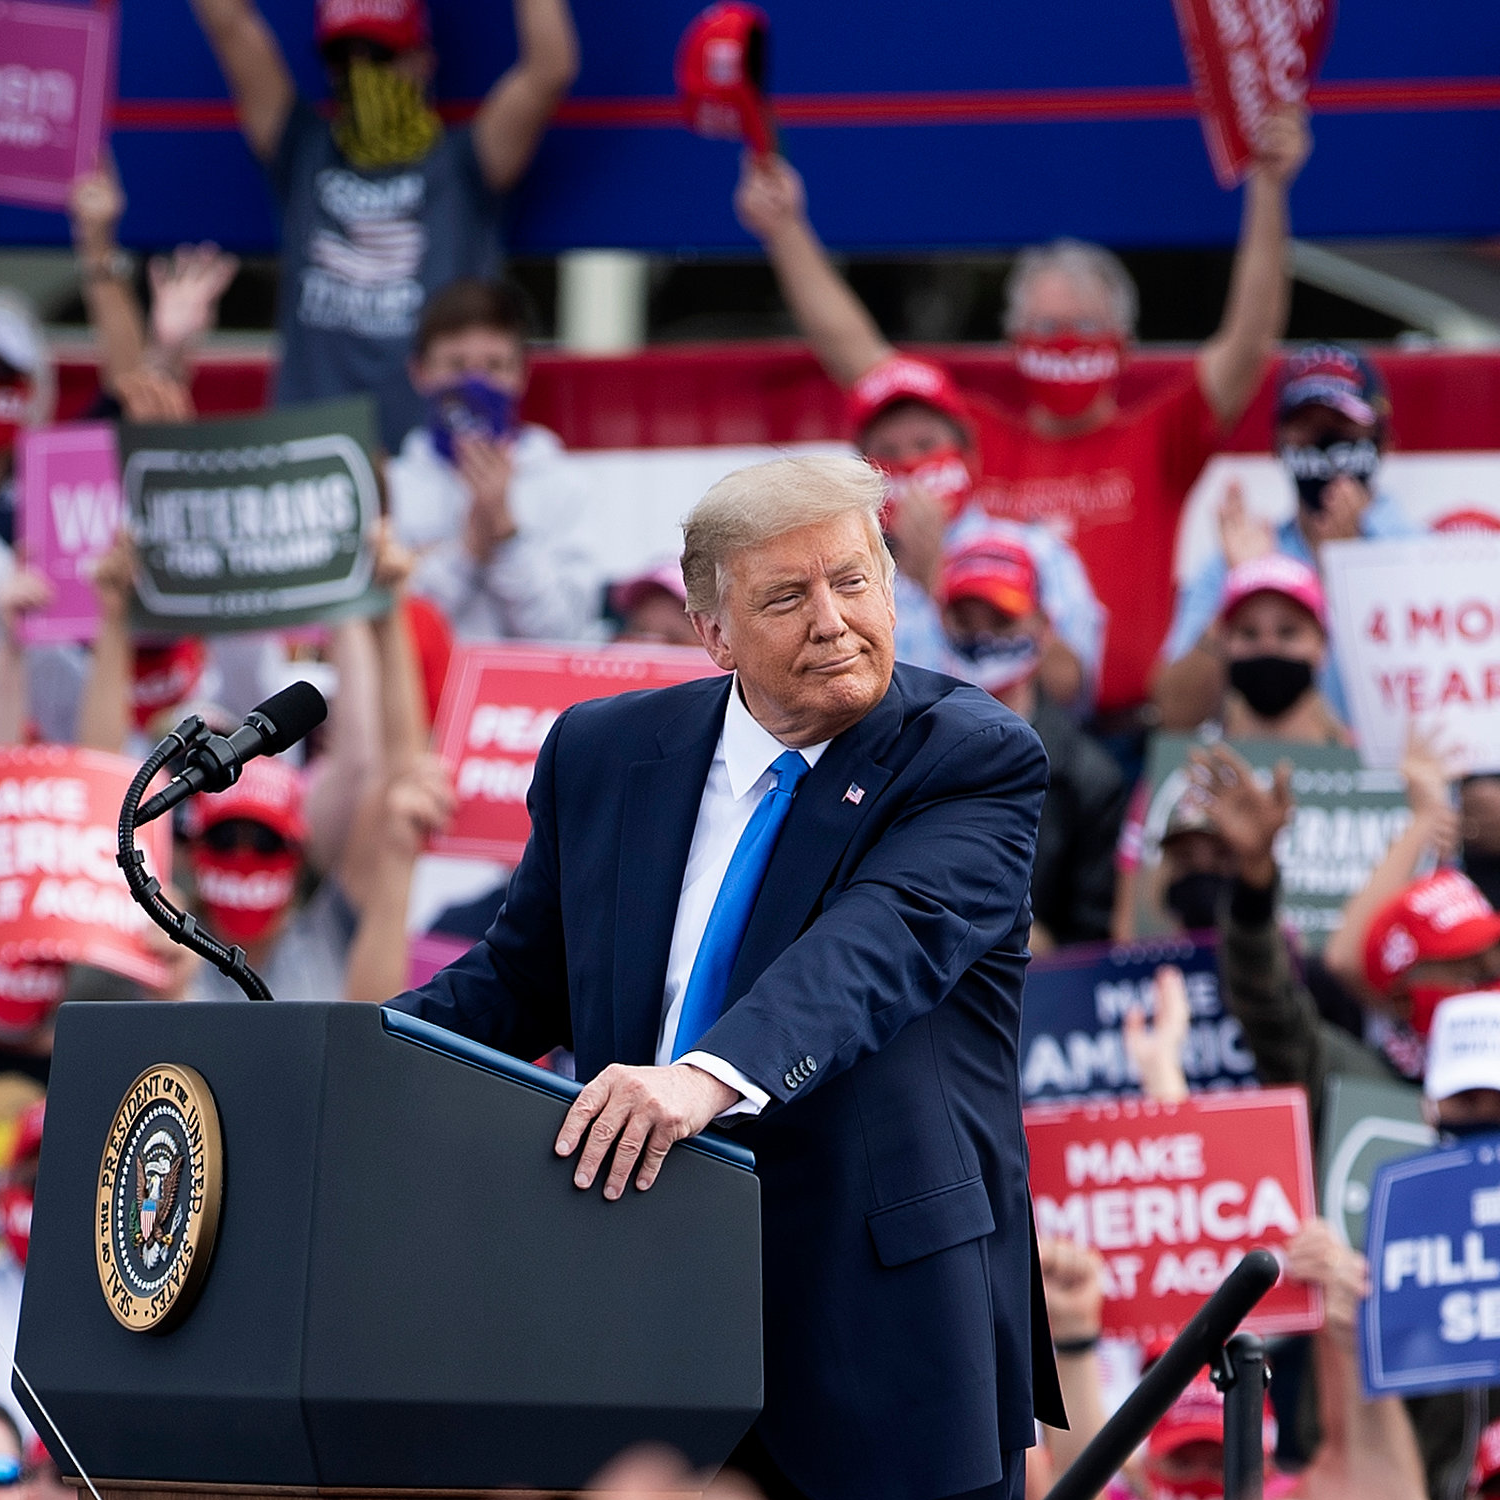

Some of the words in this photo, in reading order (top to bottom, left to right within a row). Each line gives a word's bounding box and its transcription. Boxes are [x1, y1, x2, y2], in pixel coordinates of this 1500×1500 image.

[1366, 612, 1390, 642] 4
[163, 1076, 175, 1093] OF
[174, 1082, 189, 1110] THE
[101, 1074, 162, 1191] PRESIDENT
[185, 1104, 205, 1216] UNITED
[1064, 1134, 1206, 1188] MAKE
[100, 1199, 110, 1235] THE
[1036, 1178, 1300, 1252] MERICA
[100, 1239, 111, 1263] OF
[106, 1262, 133, 1318] SEAL
[150, 1239, 195, 1320] STATES
